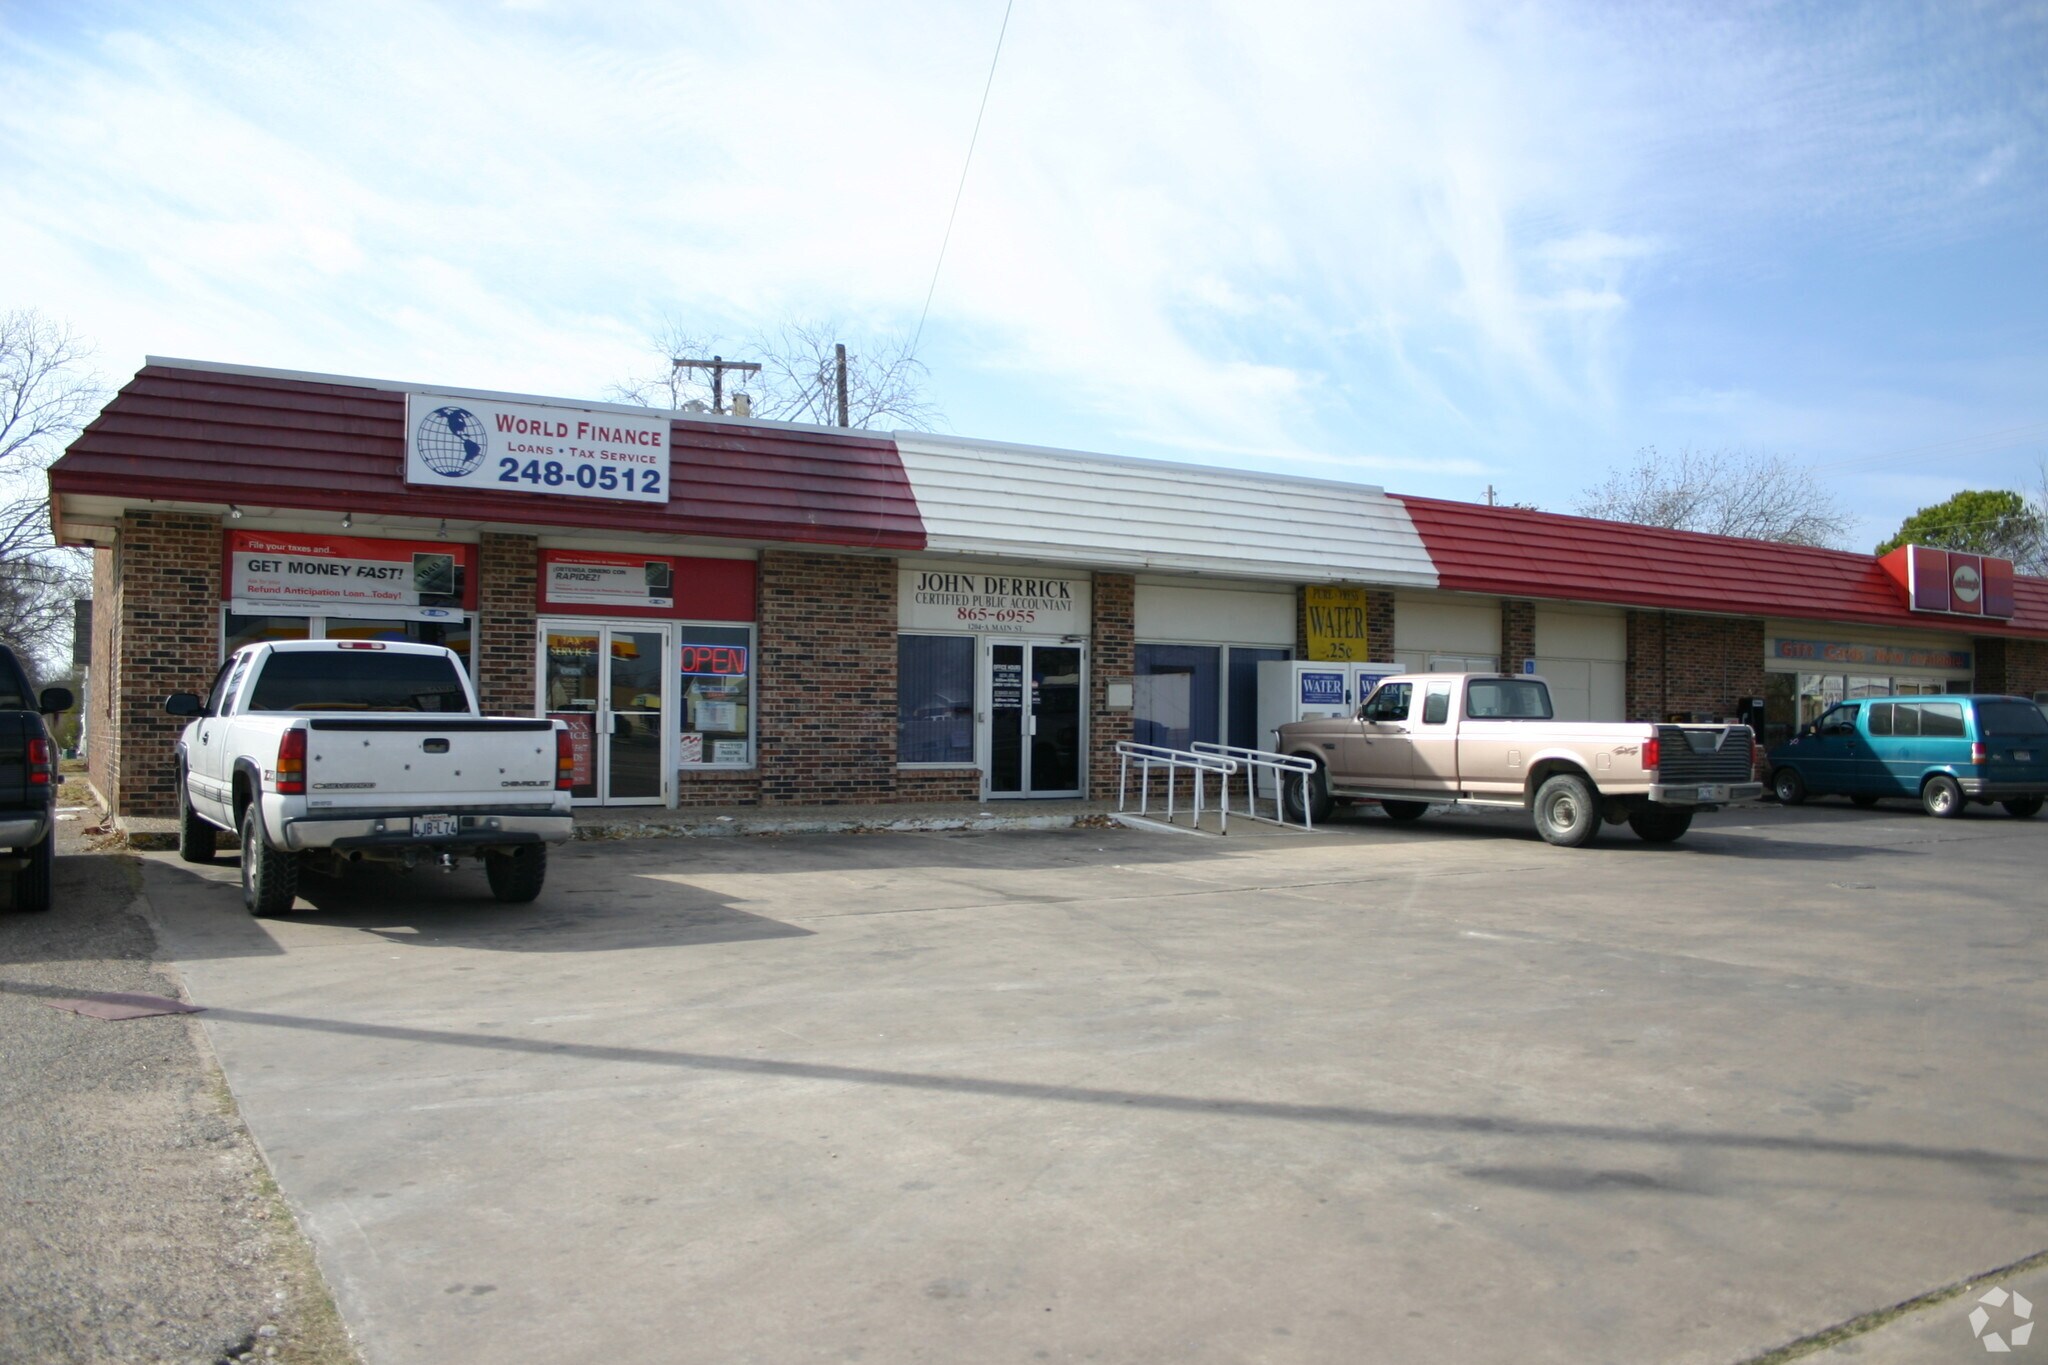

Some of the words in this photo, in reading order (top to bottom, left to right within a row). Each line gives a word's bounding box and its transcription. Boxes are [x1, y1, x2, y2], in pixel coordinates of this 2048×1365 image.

[495, 413, 568, 438] WORLD
[576, 421, 662, 447] FINANCE
[507, 441, 554, 455] LOANS
[569, 447, 596, 459] TAX
[600, 450, 657, 464] SERVICE
[498, 457, 661, 494] 248-0512
[248, 541, 264, 549] File
[288, 545, 311, 553] taxes
[248, 559, 283, 573] GET
[288, 562, 352, 577] MONEY
[356, 566, 404, 580] FAST!
[555, 573, 601, 582] RAPIDEZ!
[247, 585, 281, 594] Refund
[283, 587, 341, 597] Anticipation
[917, 573, 975, 593] JOHN
[984, 577, 1071, 599] DERRICK
[915, 592, 969, 606] CERTIFIED
[972, 596, 1006, 609] PUBLIC
[1010, 599, 1073, 612] ACCOUNTANT
[957, 607, 1035, 623] 865-6955
[1309, 606, 1364, 639] WATER
[992, 624, 1013, 632] MAIN
[1782, 642, 1813, 657] Gift
[682, 647, 745, 674] OPEN
[1303, 680, 1342, 694] WATER
[1361, 681, 1399, 695] WAER
